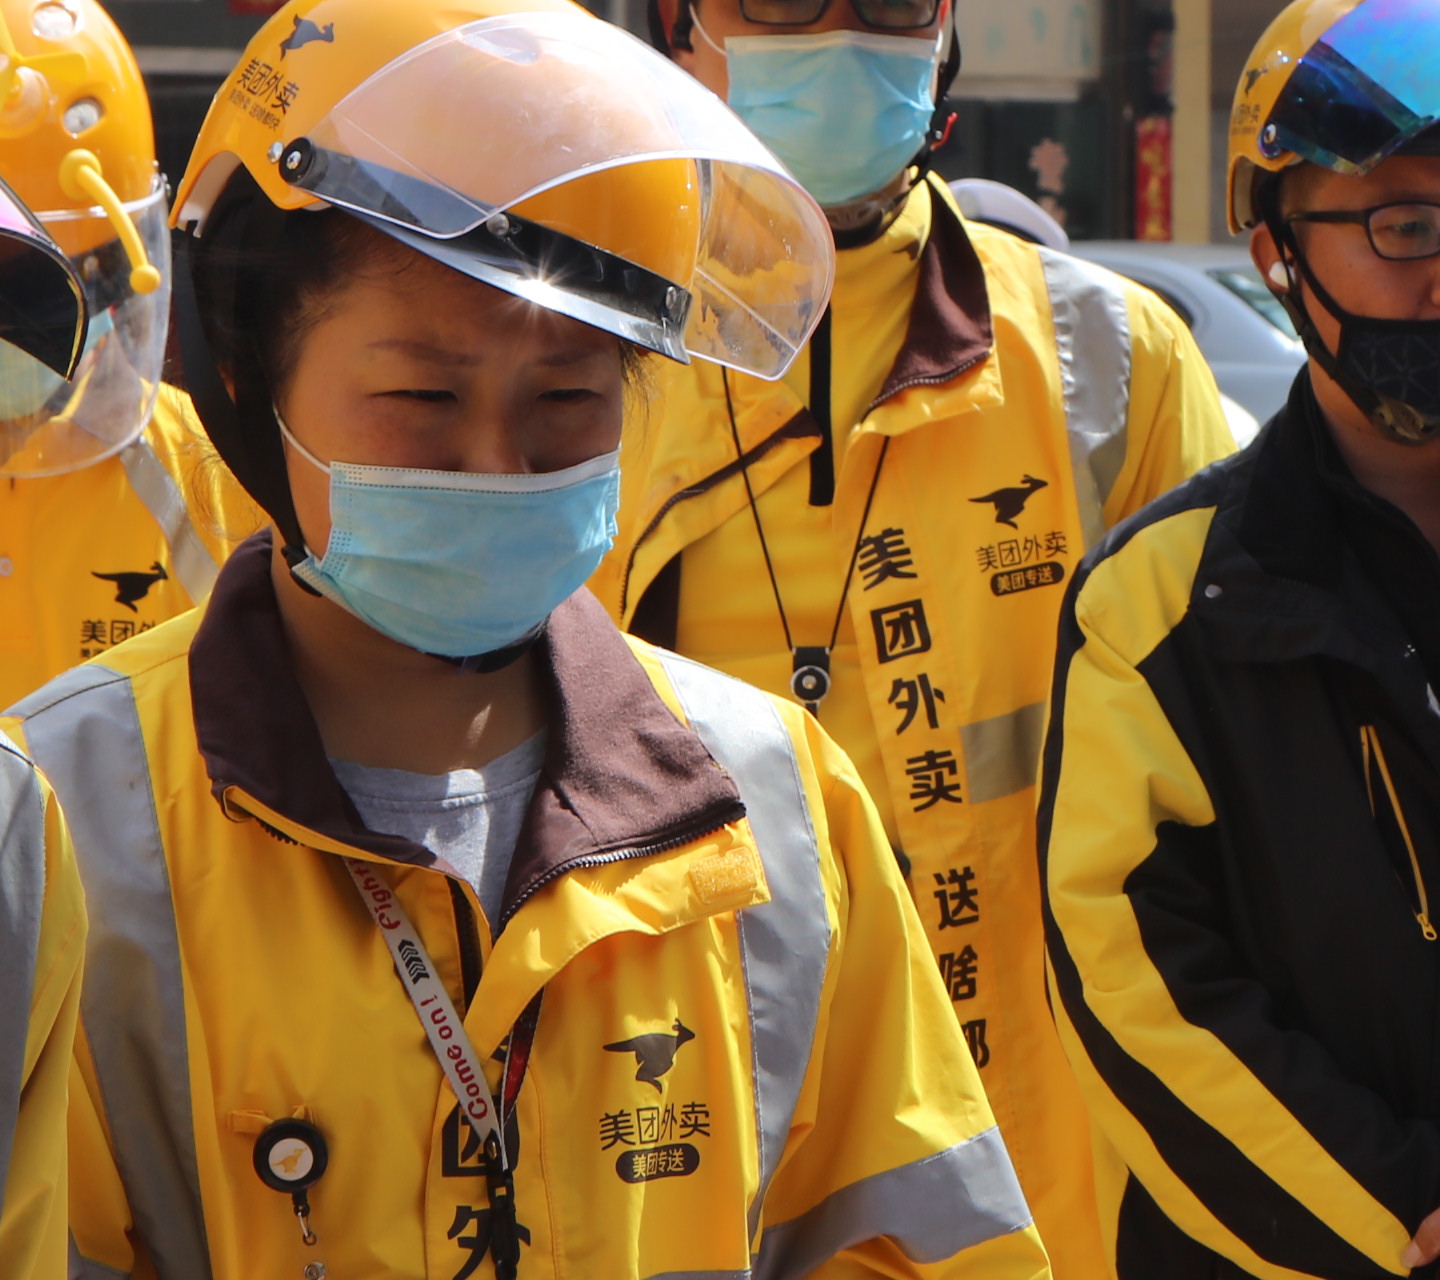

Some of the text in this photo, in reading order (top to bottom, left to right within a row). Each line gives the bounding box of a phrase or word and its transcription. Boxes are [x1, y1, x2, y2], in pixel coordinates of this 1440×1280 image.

[236, 57, 300, 115] 美团外卖
[975, 530, 1069, 573] 美团外卖
[996, 566, 1054, 595] 美团专送
[858, 527, 962, 814] 美团外卖
[446, 1043, 488, 1121] Come
[598, 1101, 712, 1149] 美团外卖
[632, 1148, 686, 1177] 美团专送
